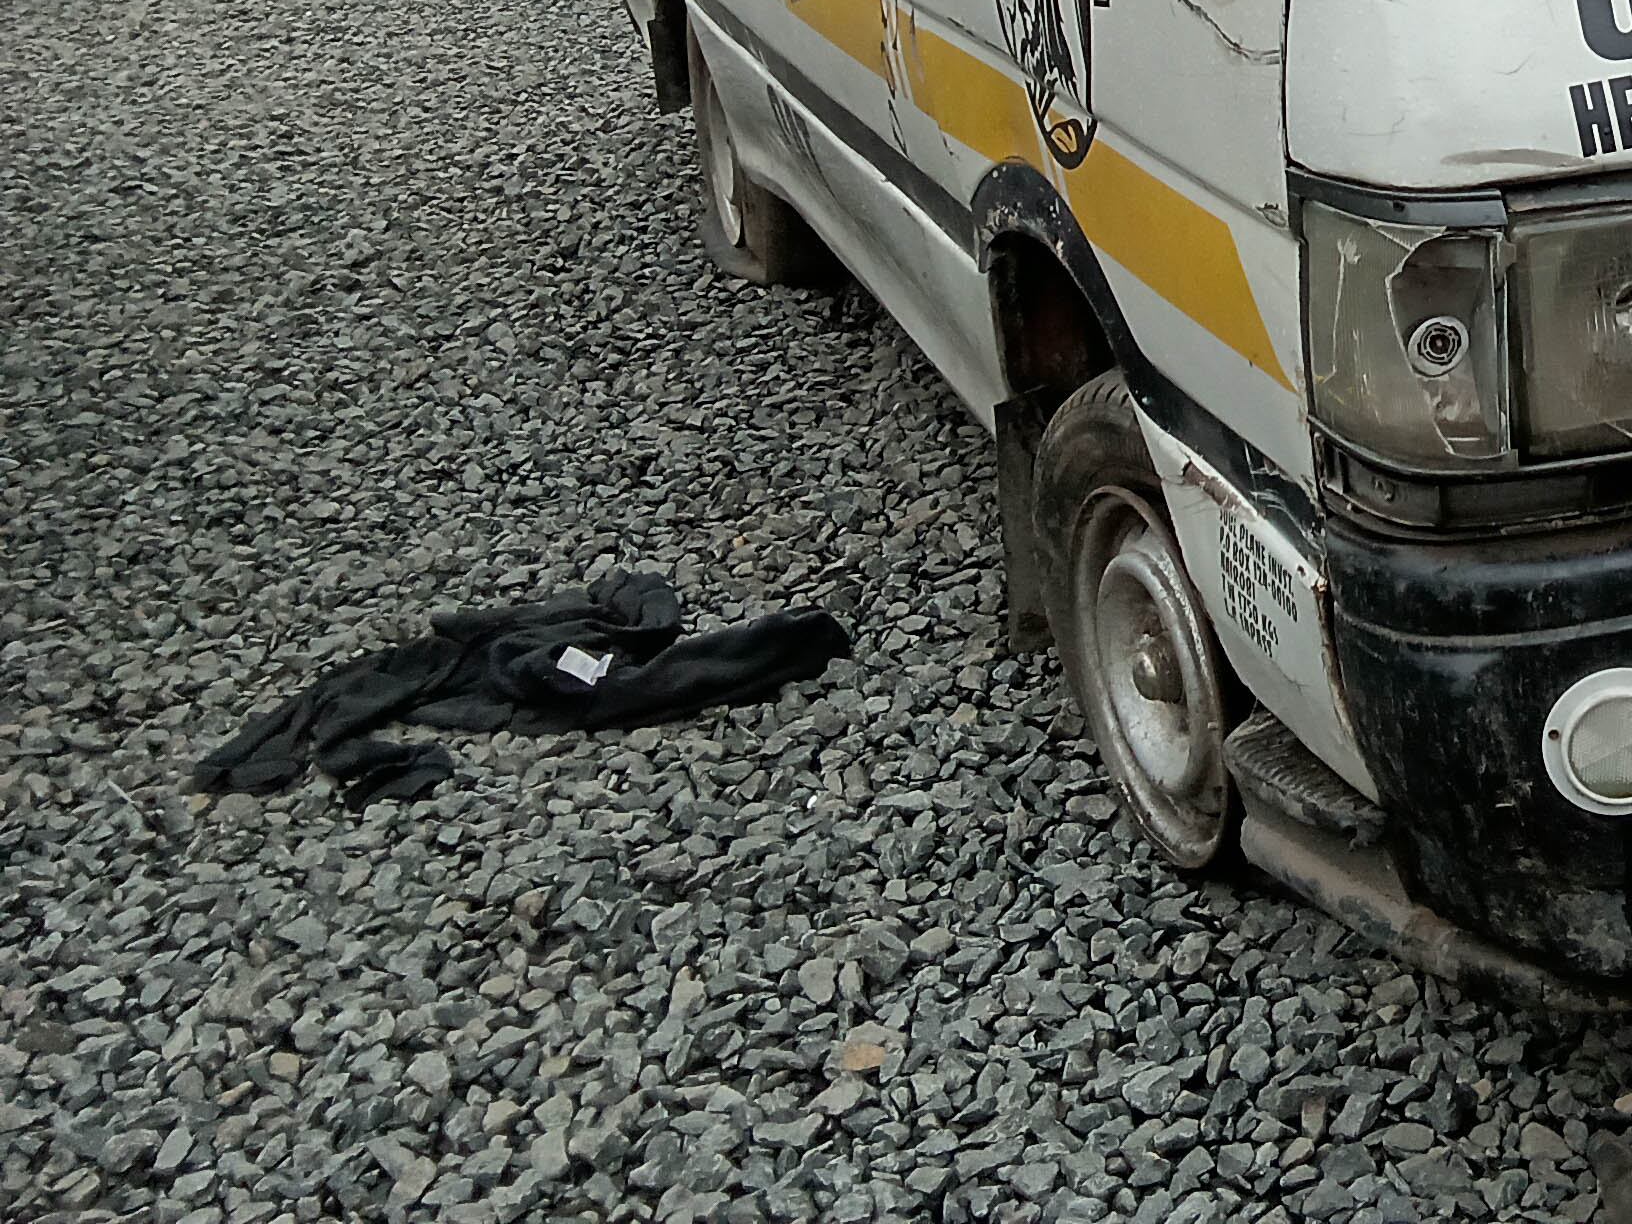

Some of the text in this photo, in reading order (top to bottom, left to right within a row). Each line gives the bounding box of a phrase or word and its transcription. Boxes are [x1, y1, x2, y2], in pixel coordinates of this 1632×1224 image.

[1232, 541, 1250, 575] BOX
[1240, 524, 1266, 567] PLANE
[1220, 550, 1256, 601] NAIROBI
